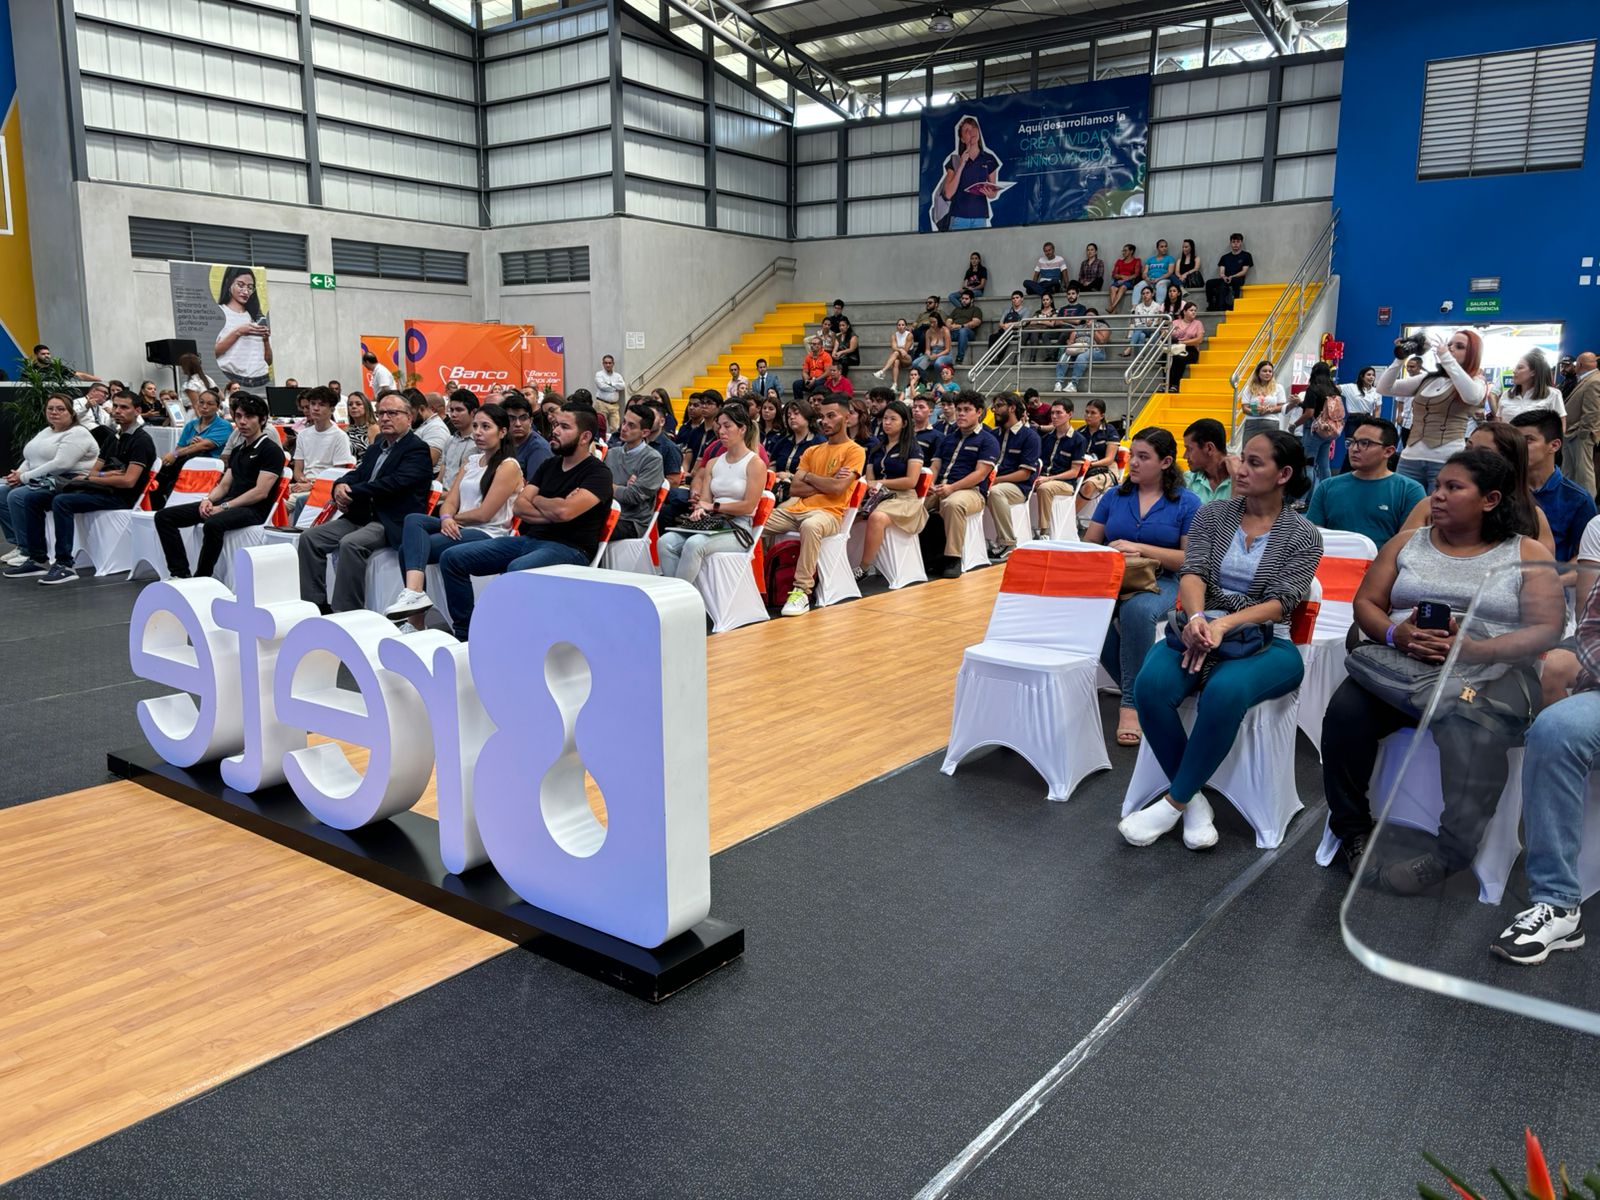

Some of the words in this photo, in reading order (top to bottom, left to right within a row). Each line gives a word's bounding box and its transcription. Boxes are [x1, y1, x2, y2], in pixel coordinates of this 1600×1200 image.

[1018, 122, 1041, 135] Aquí
[1043, 114, 1114, 131] desarrollamos
[1116, 112, 1126, 122] la
[1020, 129, 1111, 151] CREATIVIDAD
[450, 366, 508, 380] Banco
